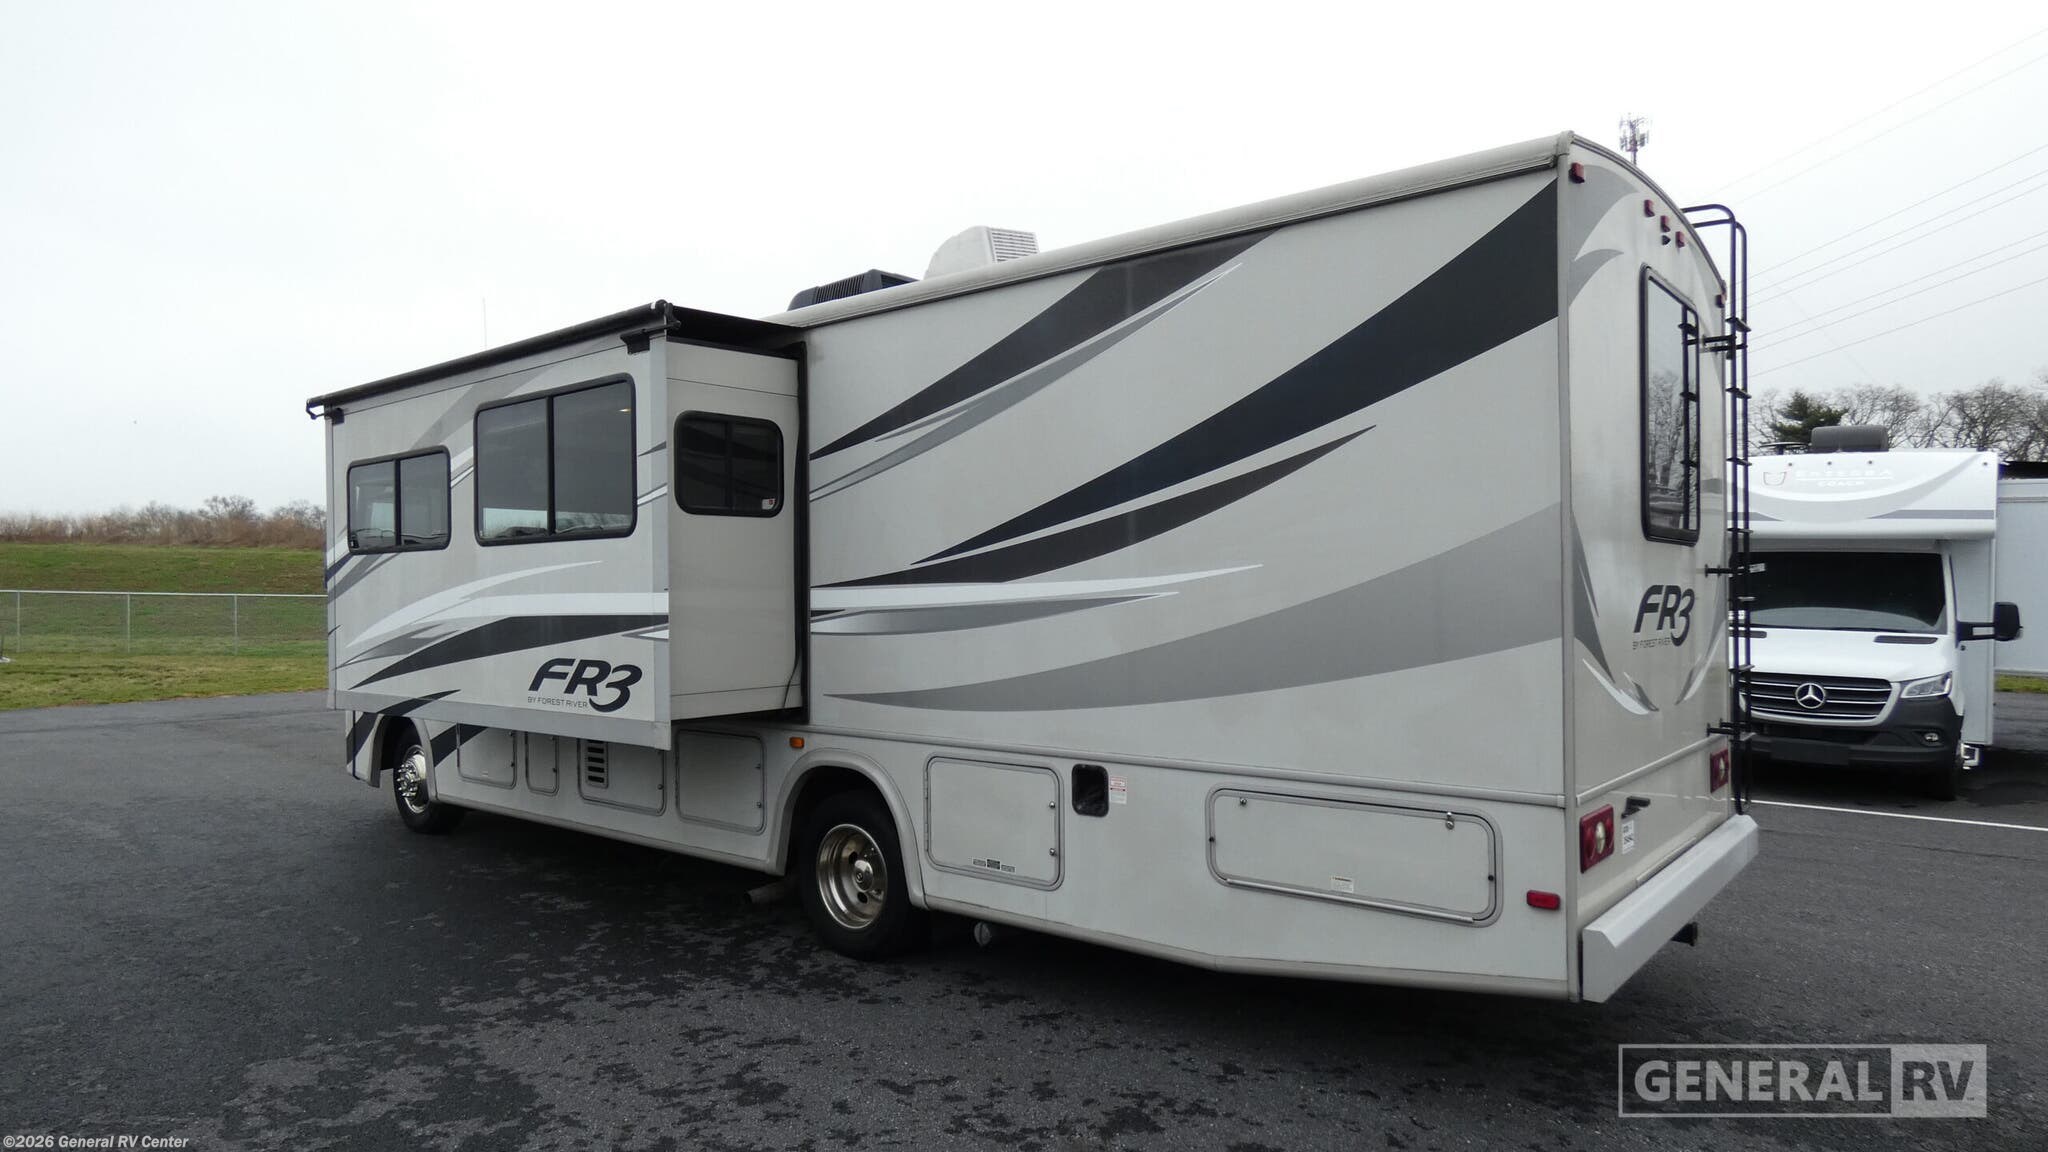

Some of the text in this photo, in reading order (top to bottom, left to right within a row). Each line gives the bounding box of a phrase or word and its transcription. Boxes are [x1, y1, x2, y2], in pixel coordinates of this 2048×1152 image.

[1633, 585, 1695, 647] FR3
[528, 658, 643, 712] FR3
[538, 697, 565, 706] FOREST
[566, 700, 588, 709] RIVER
